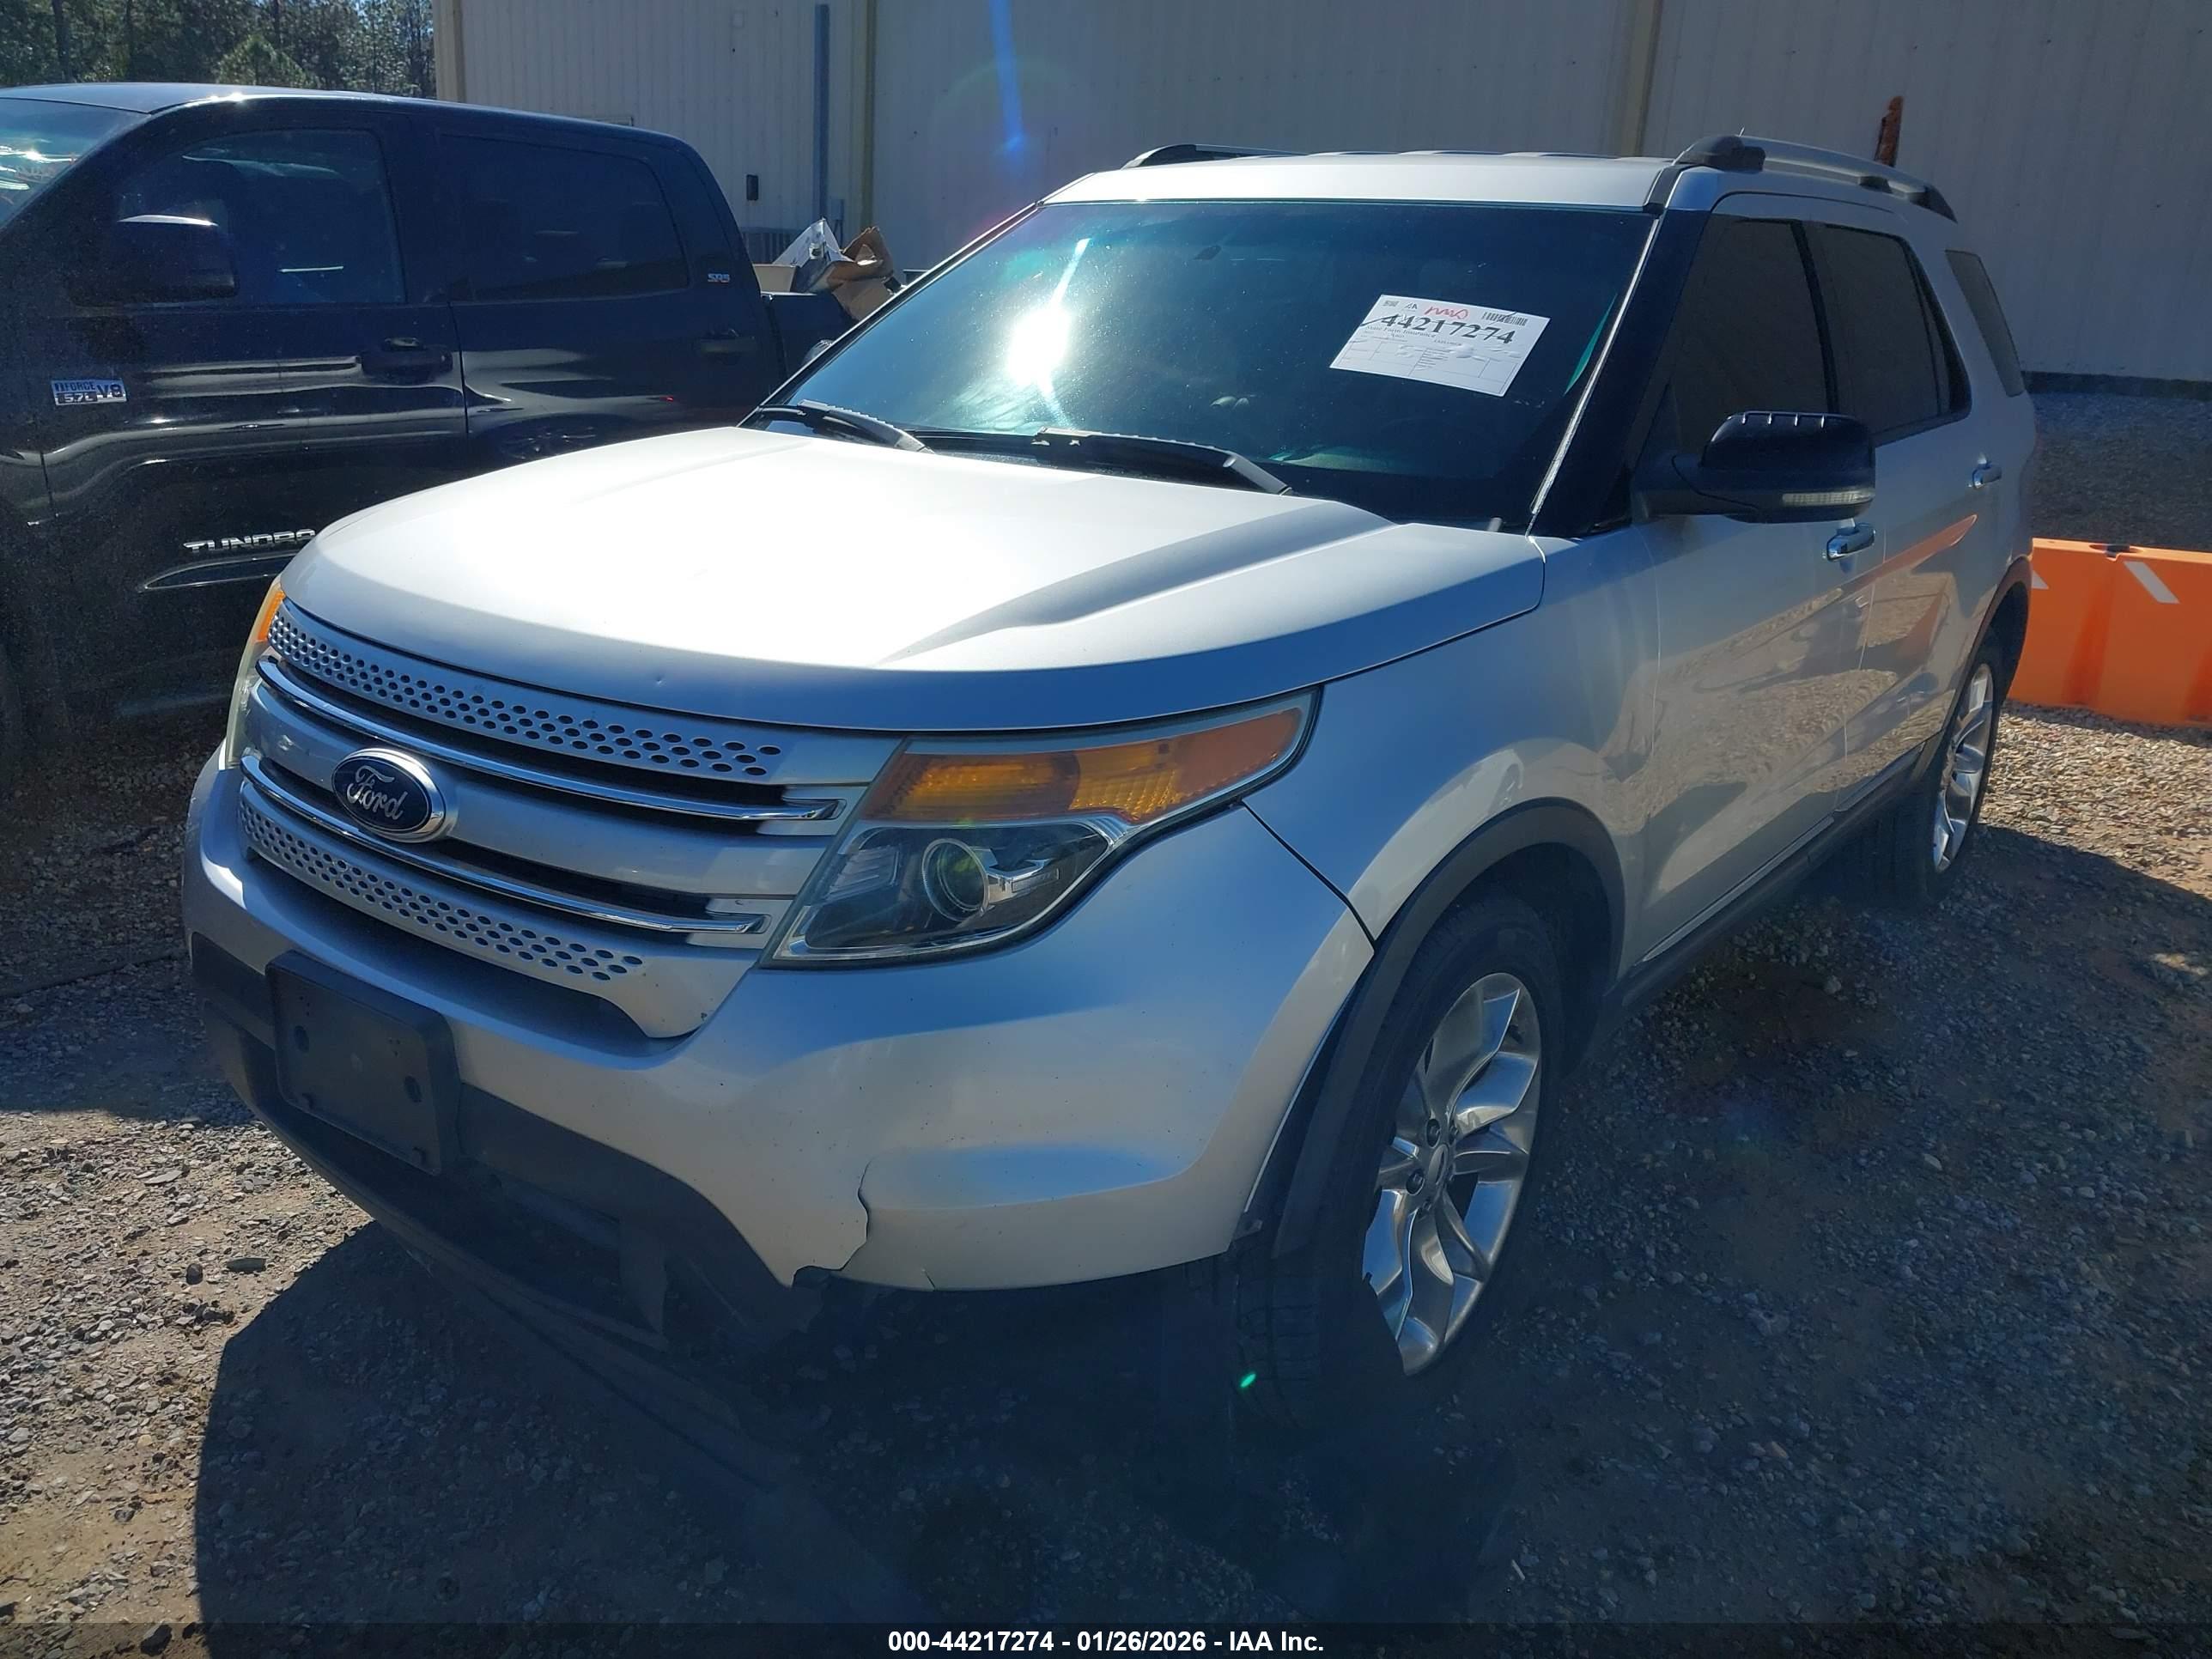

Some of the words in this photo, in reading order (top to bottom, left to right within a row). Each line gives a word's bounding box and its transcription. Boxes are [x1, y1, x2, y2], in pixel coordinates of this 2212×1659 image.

[1381, 313, 1516, 343] 44217274
[96, 383, 122, 398] V8
[346, 765, 409, 820] Ford
